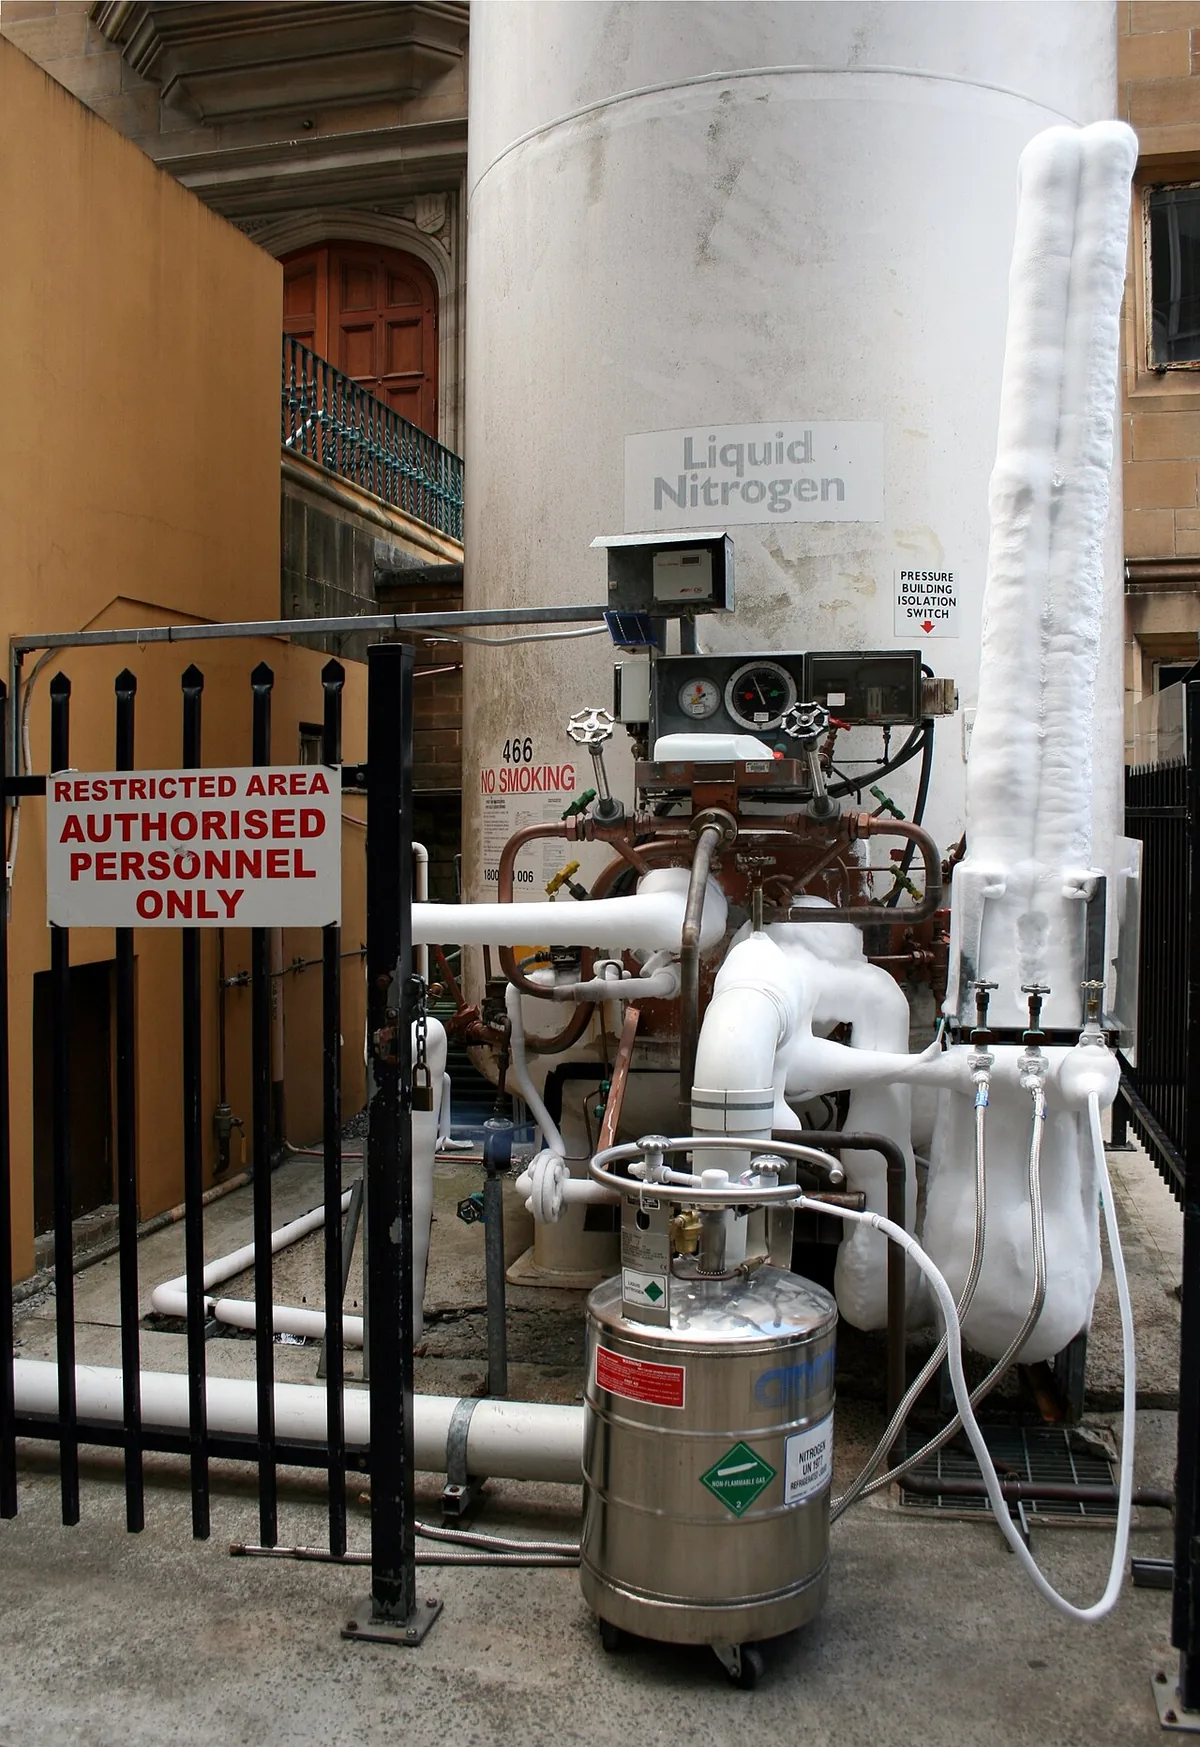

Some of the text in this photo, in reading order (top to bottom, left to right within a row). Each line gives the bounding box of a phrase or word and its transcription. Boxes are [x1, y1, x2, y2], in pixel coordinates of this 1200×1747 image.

[684, 430, 813, 477] Liquid
[654, 473, 845, 513] Nitrogen
[900, 571, 953, 582] PRESSURE
[902, 583, 952, 594] BUILDING
[897, 596, 956, 607] ISOLATION
[906, 608, 949, 619] SWITCH
[503, 737, 532, 763] 466
[54, 773, 330, 802] RESTRICTED AREA
[481, 764, 575, 793] NO SMOKING
[59, 809, 326, 843] AUTHORISED
[70, 849, 317, 881] PERSONNEL
[484, 869, 499, 881] 1800
[517, 871, 534, 882] 006
[136, 889, 244, 919] ONLY
[798, 1440, 826, 1464] NITROGEN
[802, 1462, 812, 1475] UN
[711, 1476, 766, 1488] NON-FLAMMABLE GAS
[736, 1500, 742, 1509] 2
